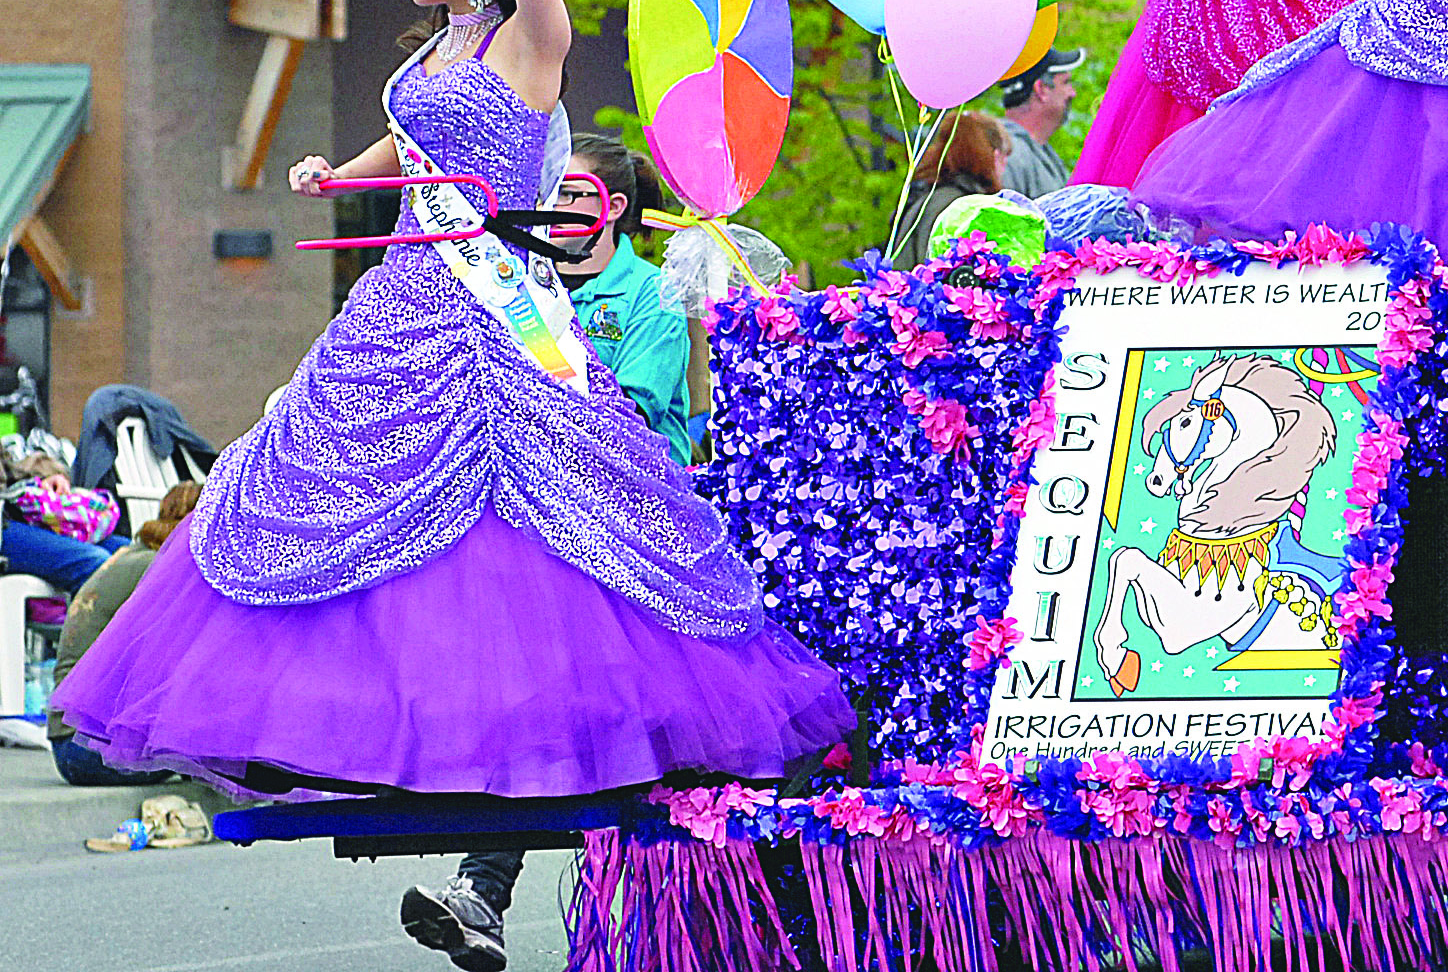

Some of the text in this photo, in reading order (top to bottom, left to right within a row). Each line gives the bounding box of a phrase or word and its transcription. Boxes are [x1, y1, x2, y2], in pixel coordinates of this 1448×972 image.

[421, 183, 481, 267] Stephnie
[1067, 285, 1162, 307] WHERE
[1170, 284, 1256, 305] WATER
[1264, 283, 1290, 304] IS
[1204, 402, 1222, 418] 116
[1001, 353, 1110, 701] SEQUIM
[994, 713, 1177, 739] IRRIGATION
[990, 741, 1029, 760] One
[1174, 738, 1251, 758] SWEE
